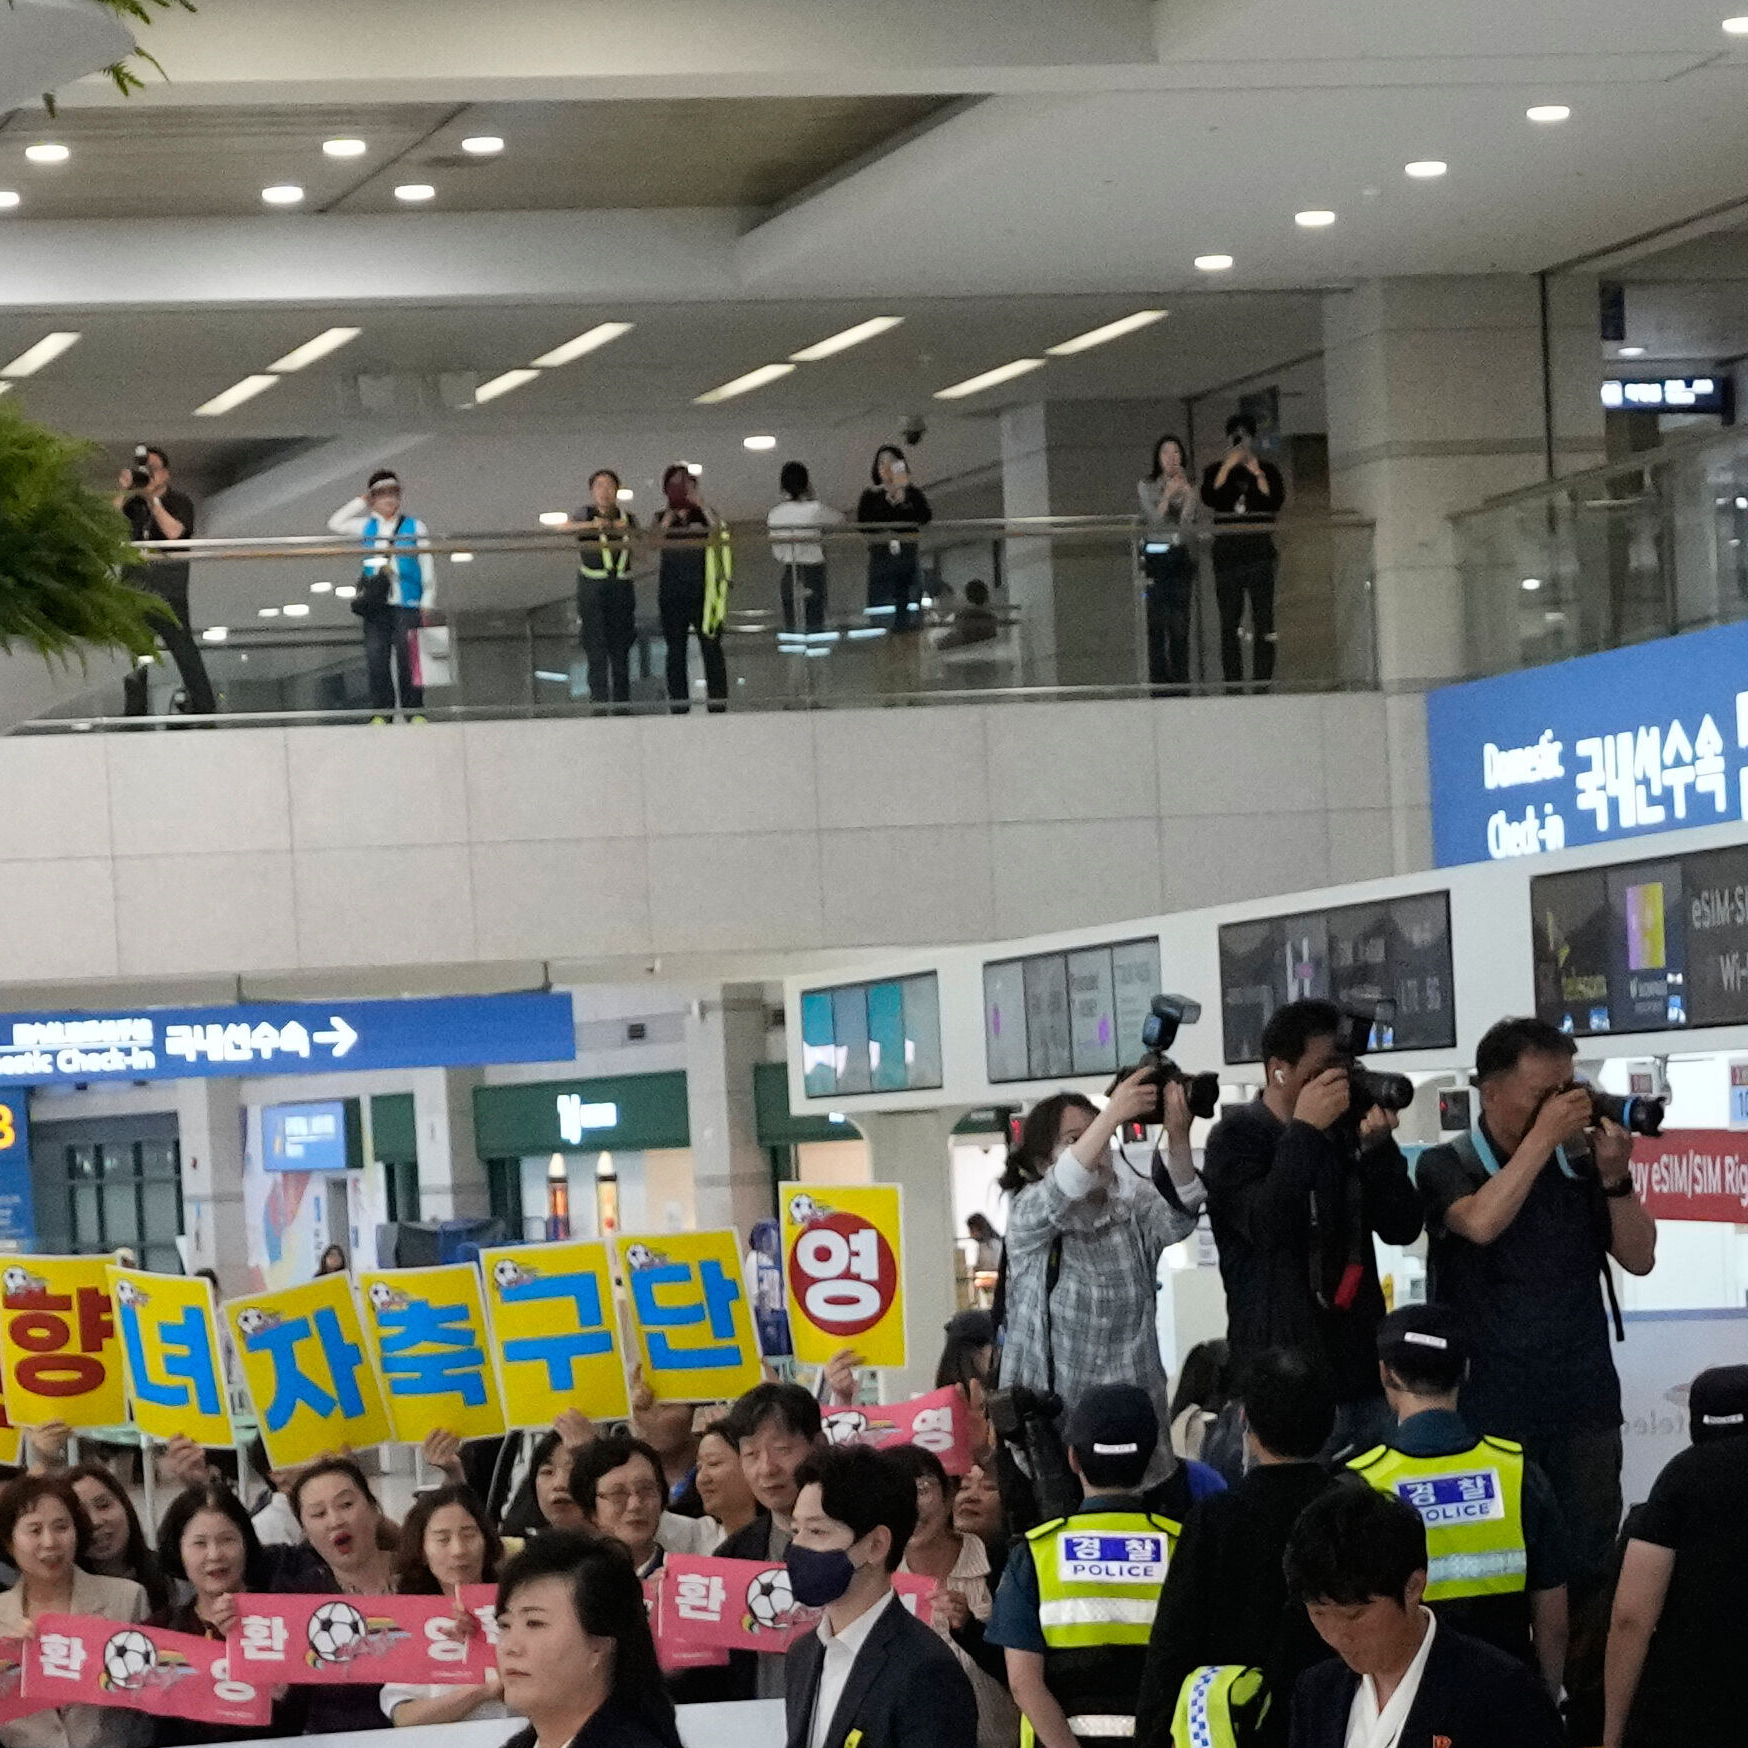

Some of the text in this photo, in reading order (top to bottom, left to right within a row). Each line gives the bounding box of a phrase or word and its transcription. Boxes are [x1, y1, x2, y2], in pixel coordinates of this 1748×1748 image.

[1483, 729, 1565, 790] Domestic
[1575, 713, 1726, 832] 국내선수속
[1487, 803, 1565, 859] Check-in
[56, 1046, 155, 1073] Check-in
[165, 1019, 310, 1061] 국내선수속
[1652, 1149, 1721, 1198] eSIM/SIM
[795, 1226, 880, 1322] 영
[2, 1285, 114, 1396] 향
[120, 1301, 222, 1416] 녀
[245, 1304, 365, 1432] 자
[379, 1297, 488, 1405] 축
[500, 1271, 614, 1391] 구
[631, 1259, 744, 1370] 단
[912, 1406, 955, 1452] 영
[1425, 1502, 1490, 1521] OLICE
[1073, 1564, 1155, 1577] POLICE
[675, 1573, 727, 1622] 환
[38, 1633, 88, 1680] 환
[240, 1615, 290, 1661] 환
